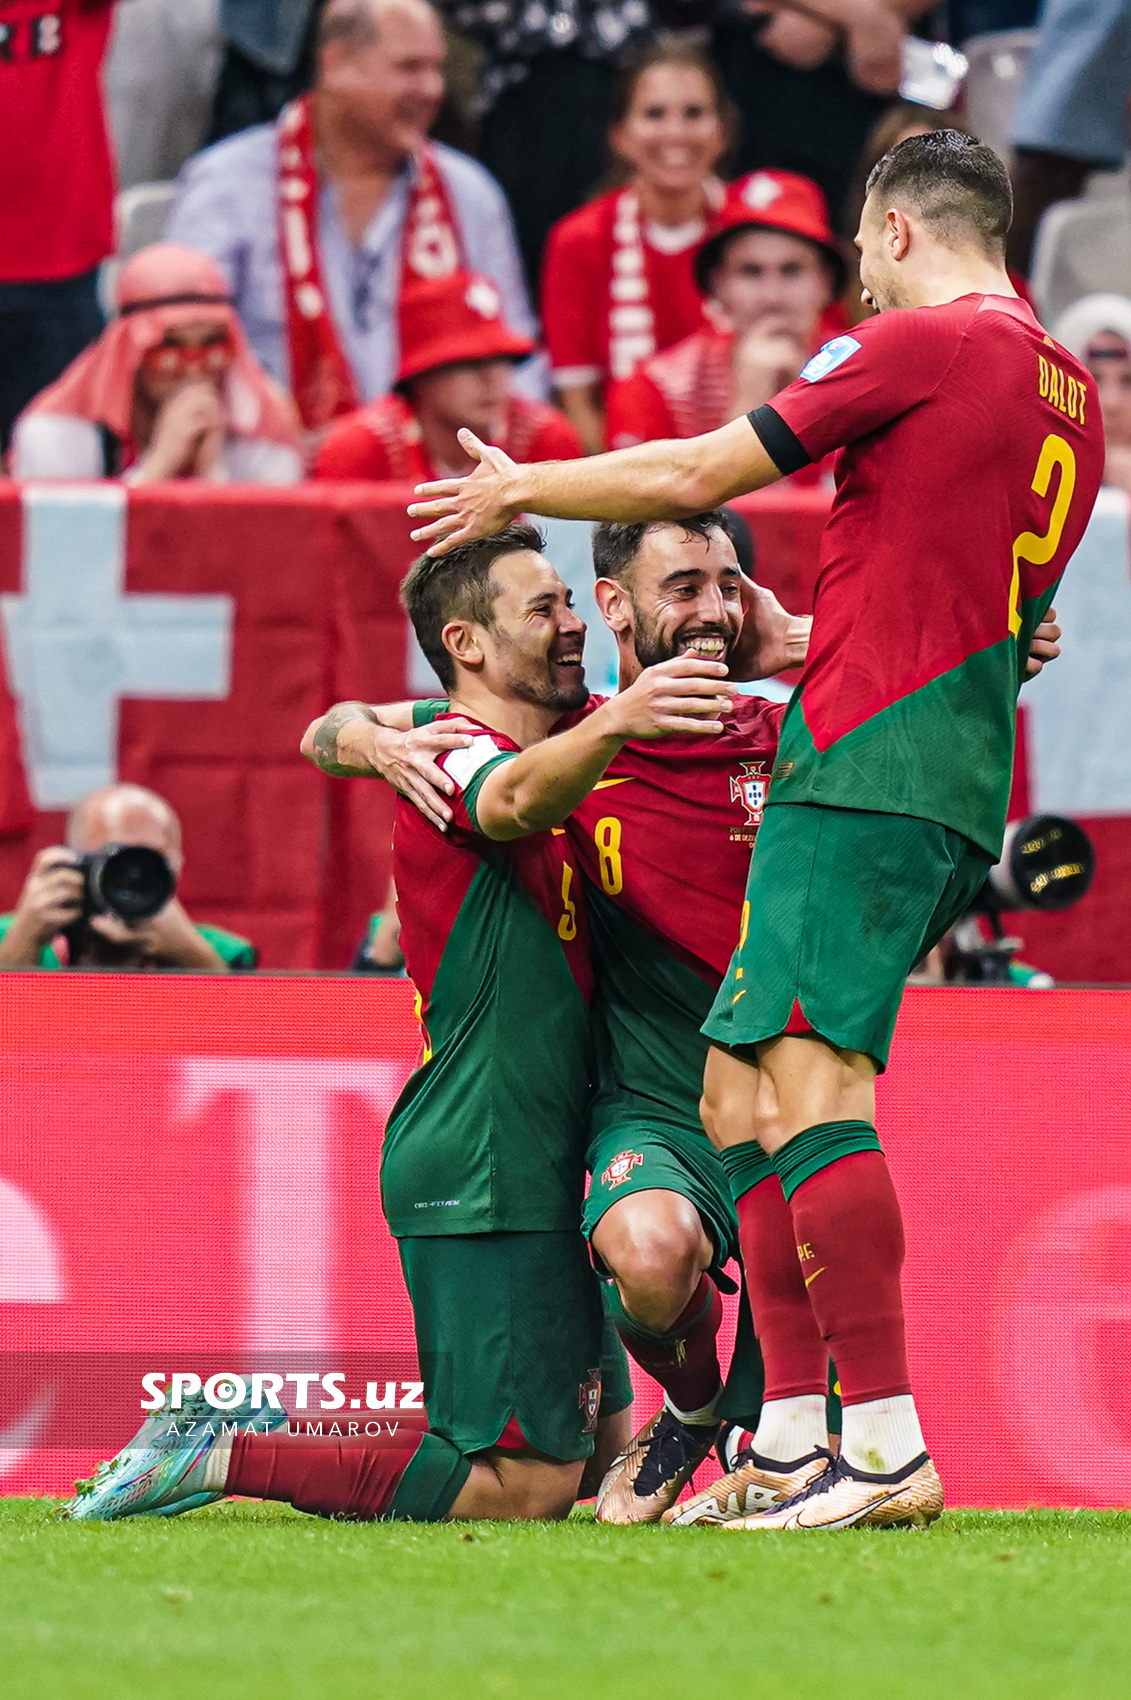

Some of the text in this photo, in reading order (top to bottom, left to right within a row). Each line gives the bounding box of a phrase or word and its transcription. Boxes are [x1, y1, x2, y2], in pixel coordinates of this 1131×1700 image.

[1037, 354, 1088, 426] DALOT
[1007, 433, 1077, 641] 2
[594, 816, 625, 896] 8
